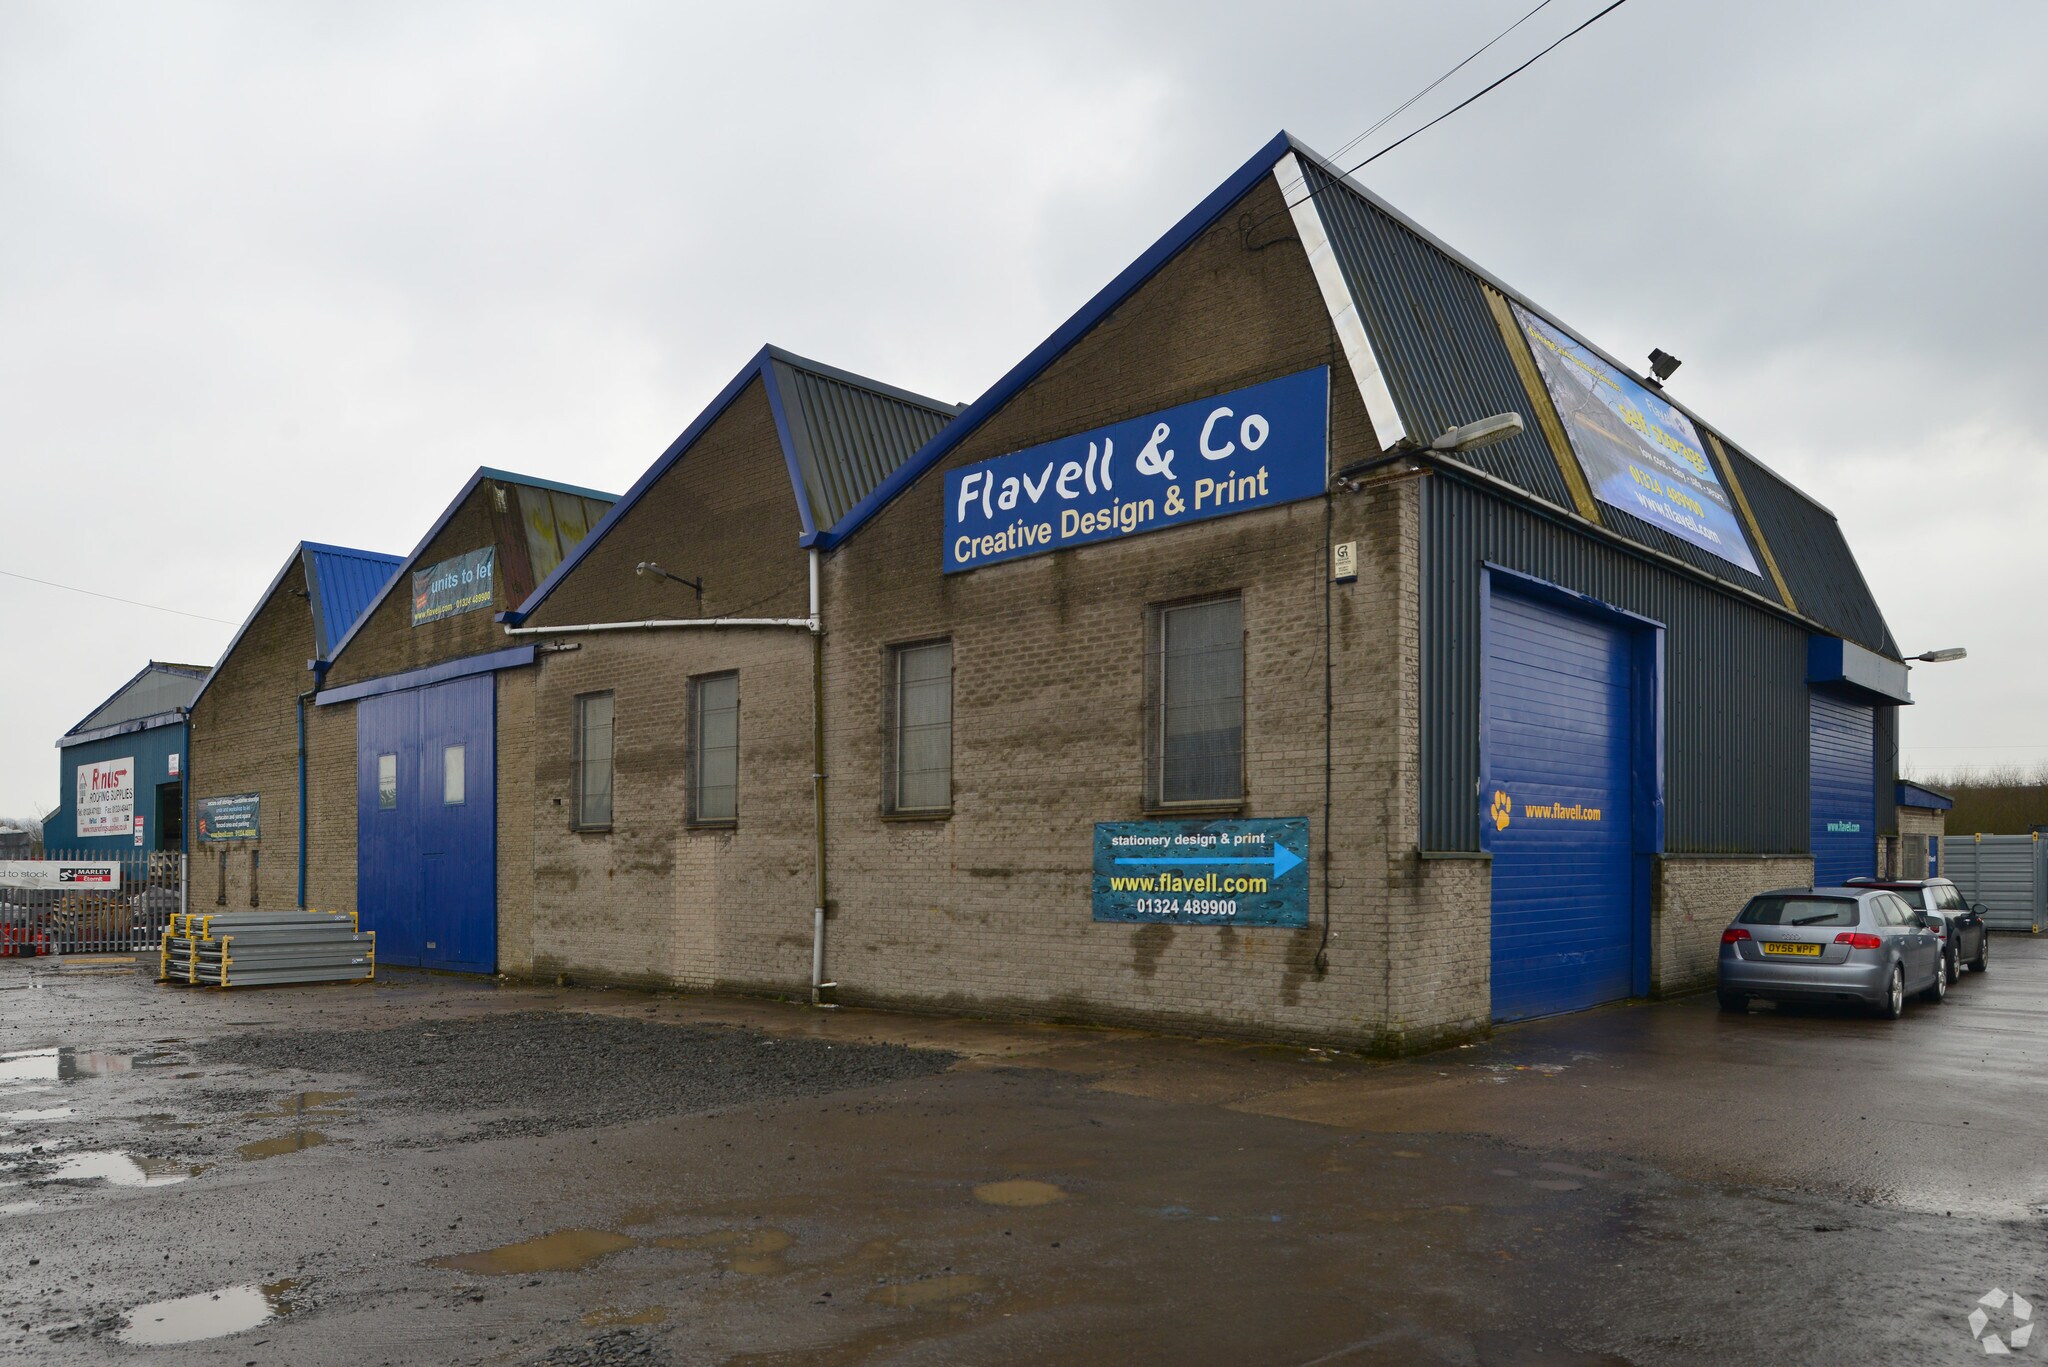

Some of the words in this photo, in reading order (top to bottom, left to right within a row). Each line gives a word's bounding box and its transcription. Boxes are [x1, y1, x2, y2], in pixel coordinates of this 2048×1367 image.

[1618, 403, 1651, 437] self
[1650, 423, 1708, 474] storage
[957, 437, 1114, 524] Flavell
[1135, 422, 1177, 480] &
[1199, 406, 1270, 461] Co
[954, 518, 1052, 563] Creative
[1061, 497, 1155, 533] Design
[1163, 484, 1186, 516] &
[1194, 465, 1269, 511] Print
[1634, 490, 1722, 545] www.flavell.com
[431, 573, 458, 594] units
[461, 568, 473, 584] to
[476, 561, 492, 580] let
[92, 768, 120, 790] Rnus
[110, 788, 133, 801] SUPPLIES
[1525, 802, 1601, 820] www.flavell.com
[1111, 833, 1171, 848] stationery
[1174, 833, 1217, 848] design
[1220, 833, 1231, 844] &
[1234, 832, 1266, 847] print
[20, 870, 48, 878] stock
[1110, 873, 1268, 893] www.flavell.com
[1137, 898, 1179, 914] 01324
[1183, 899, 1237, 915] 489900
[1768, 943, 1794, 953] OY56
[1796, 945, 1816, 954] WPF
